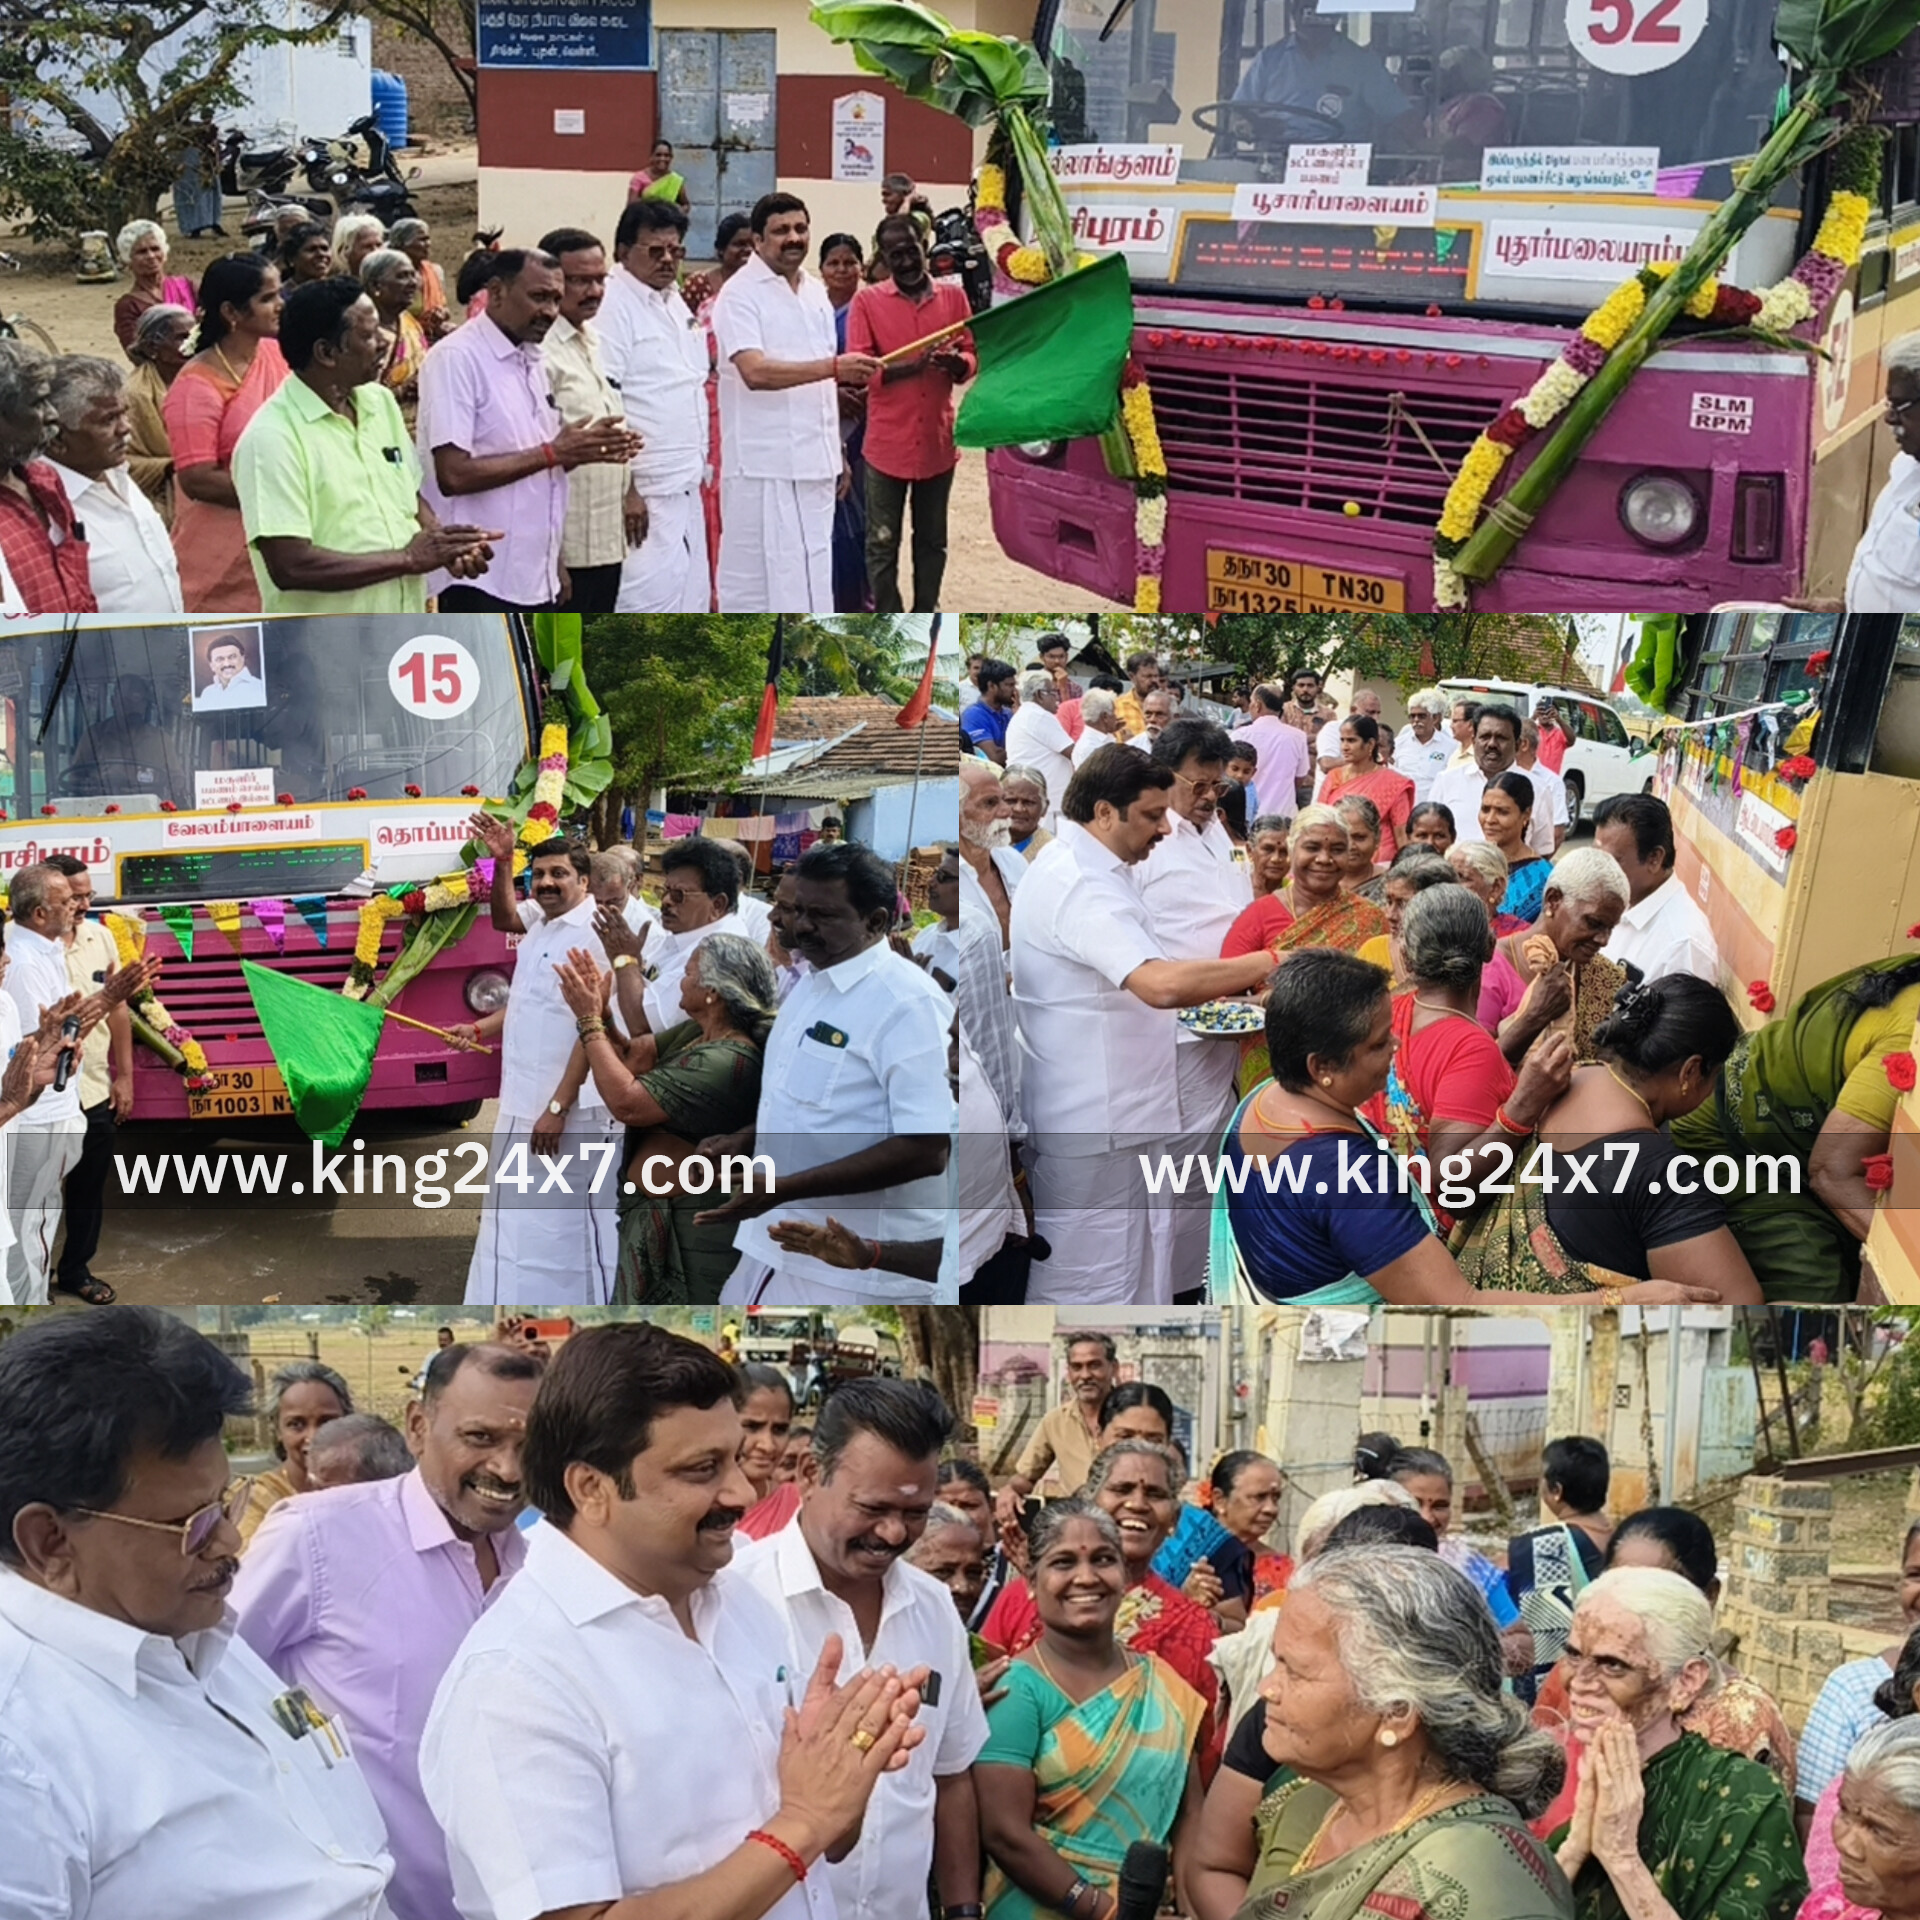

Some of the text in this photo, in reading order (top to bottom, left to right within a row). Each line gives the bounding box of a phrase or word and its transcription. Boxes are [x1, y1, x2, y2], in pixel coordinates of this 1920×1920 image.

[1587, 0, 1681, 45] 52
[1050, 146, 1176, 180] ல்லாங்குளம்
[1252, 189, 1429, 216] பூசாரிபாளையம்
[1070, 206, 1165, 245] சிபுரம்
[1699, 396, 1746, 412] SLM
[1696, 414, 1746, 430] RPM
[1322, 573, 1385, 604] TN30
[398, 652, 462, 704] 15
[168, 815, 314, 836] வேலம்பாளையம்
